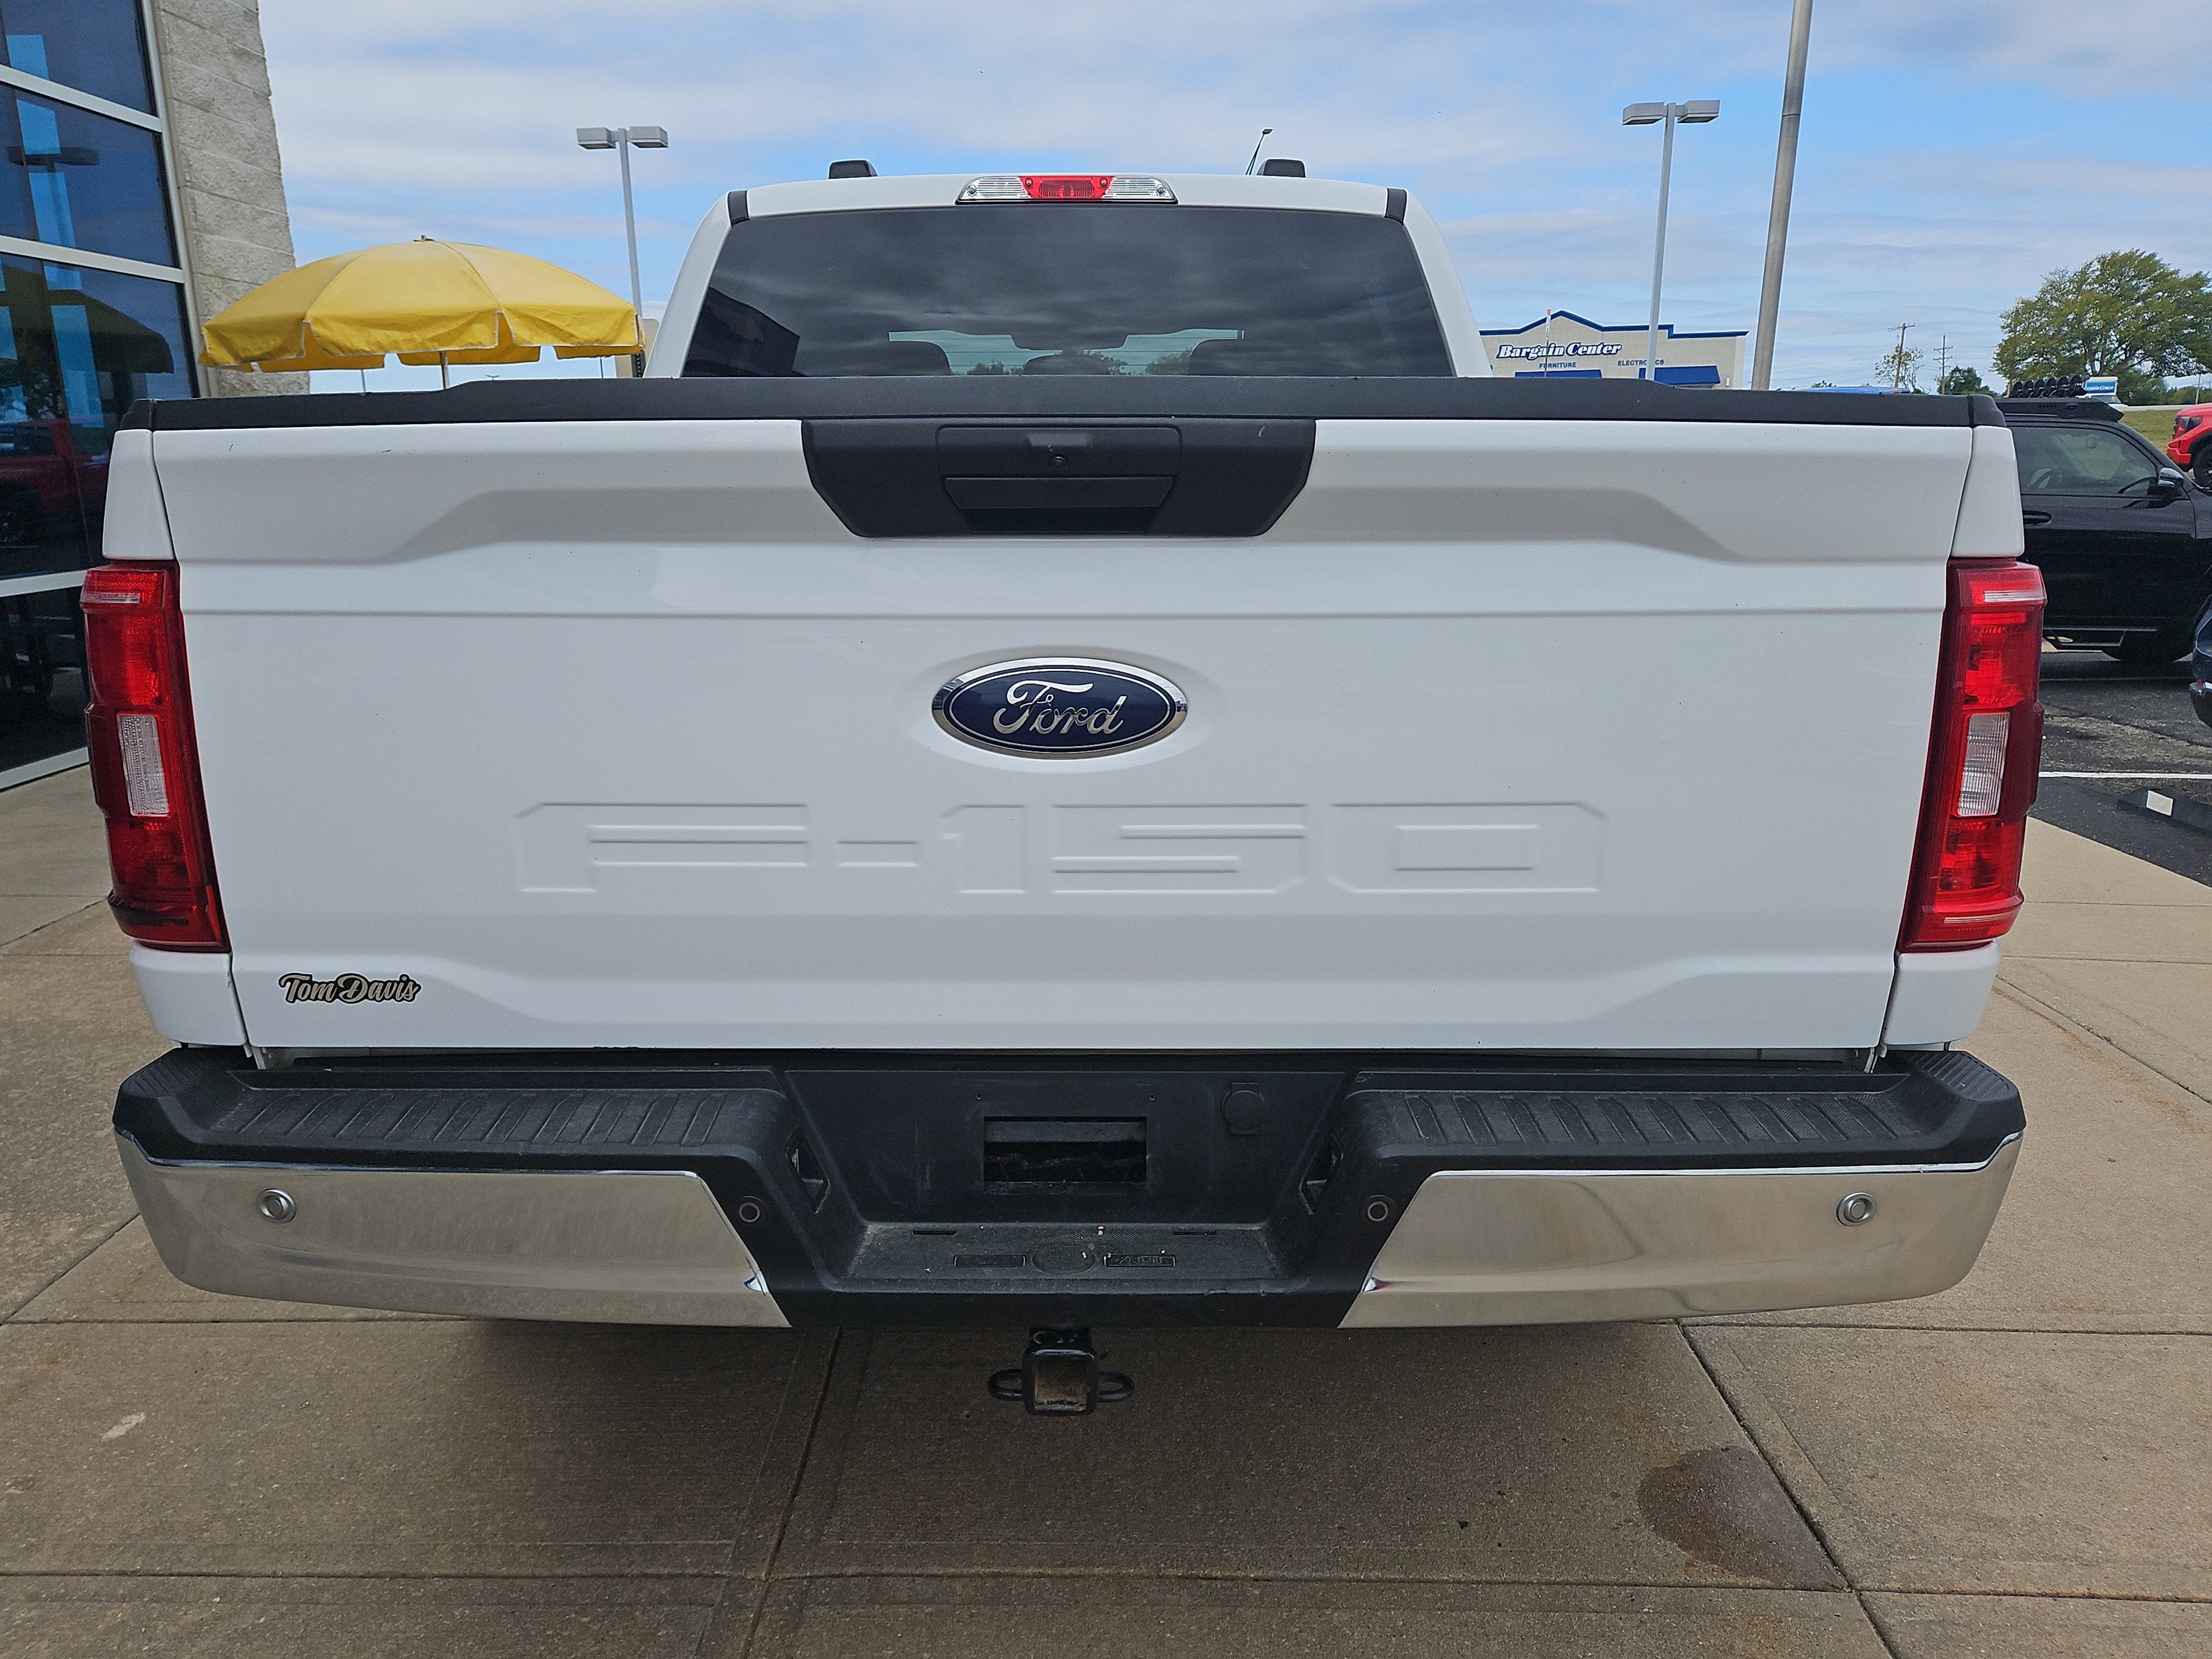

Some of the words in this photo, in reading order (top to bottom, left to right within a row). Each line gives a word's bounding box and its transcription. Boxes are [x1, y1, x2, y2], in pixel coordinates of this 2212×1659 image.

[1497, 343, 1564, 360] Bargain
[1566, 342, 1622, 355] Center
[993, 679, 1127, 735] Ford
[517, 802, 1608, 895] F-150
[280, 974, 338, 1002] Tom
[337, 973, 420, 1003] Davis
